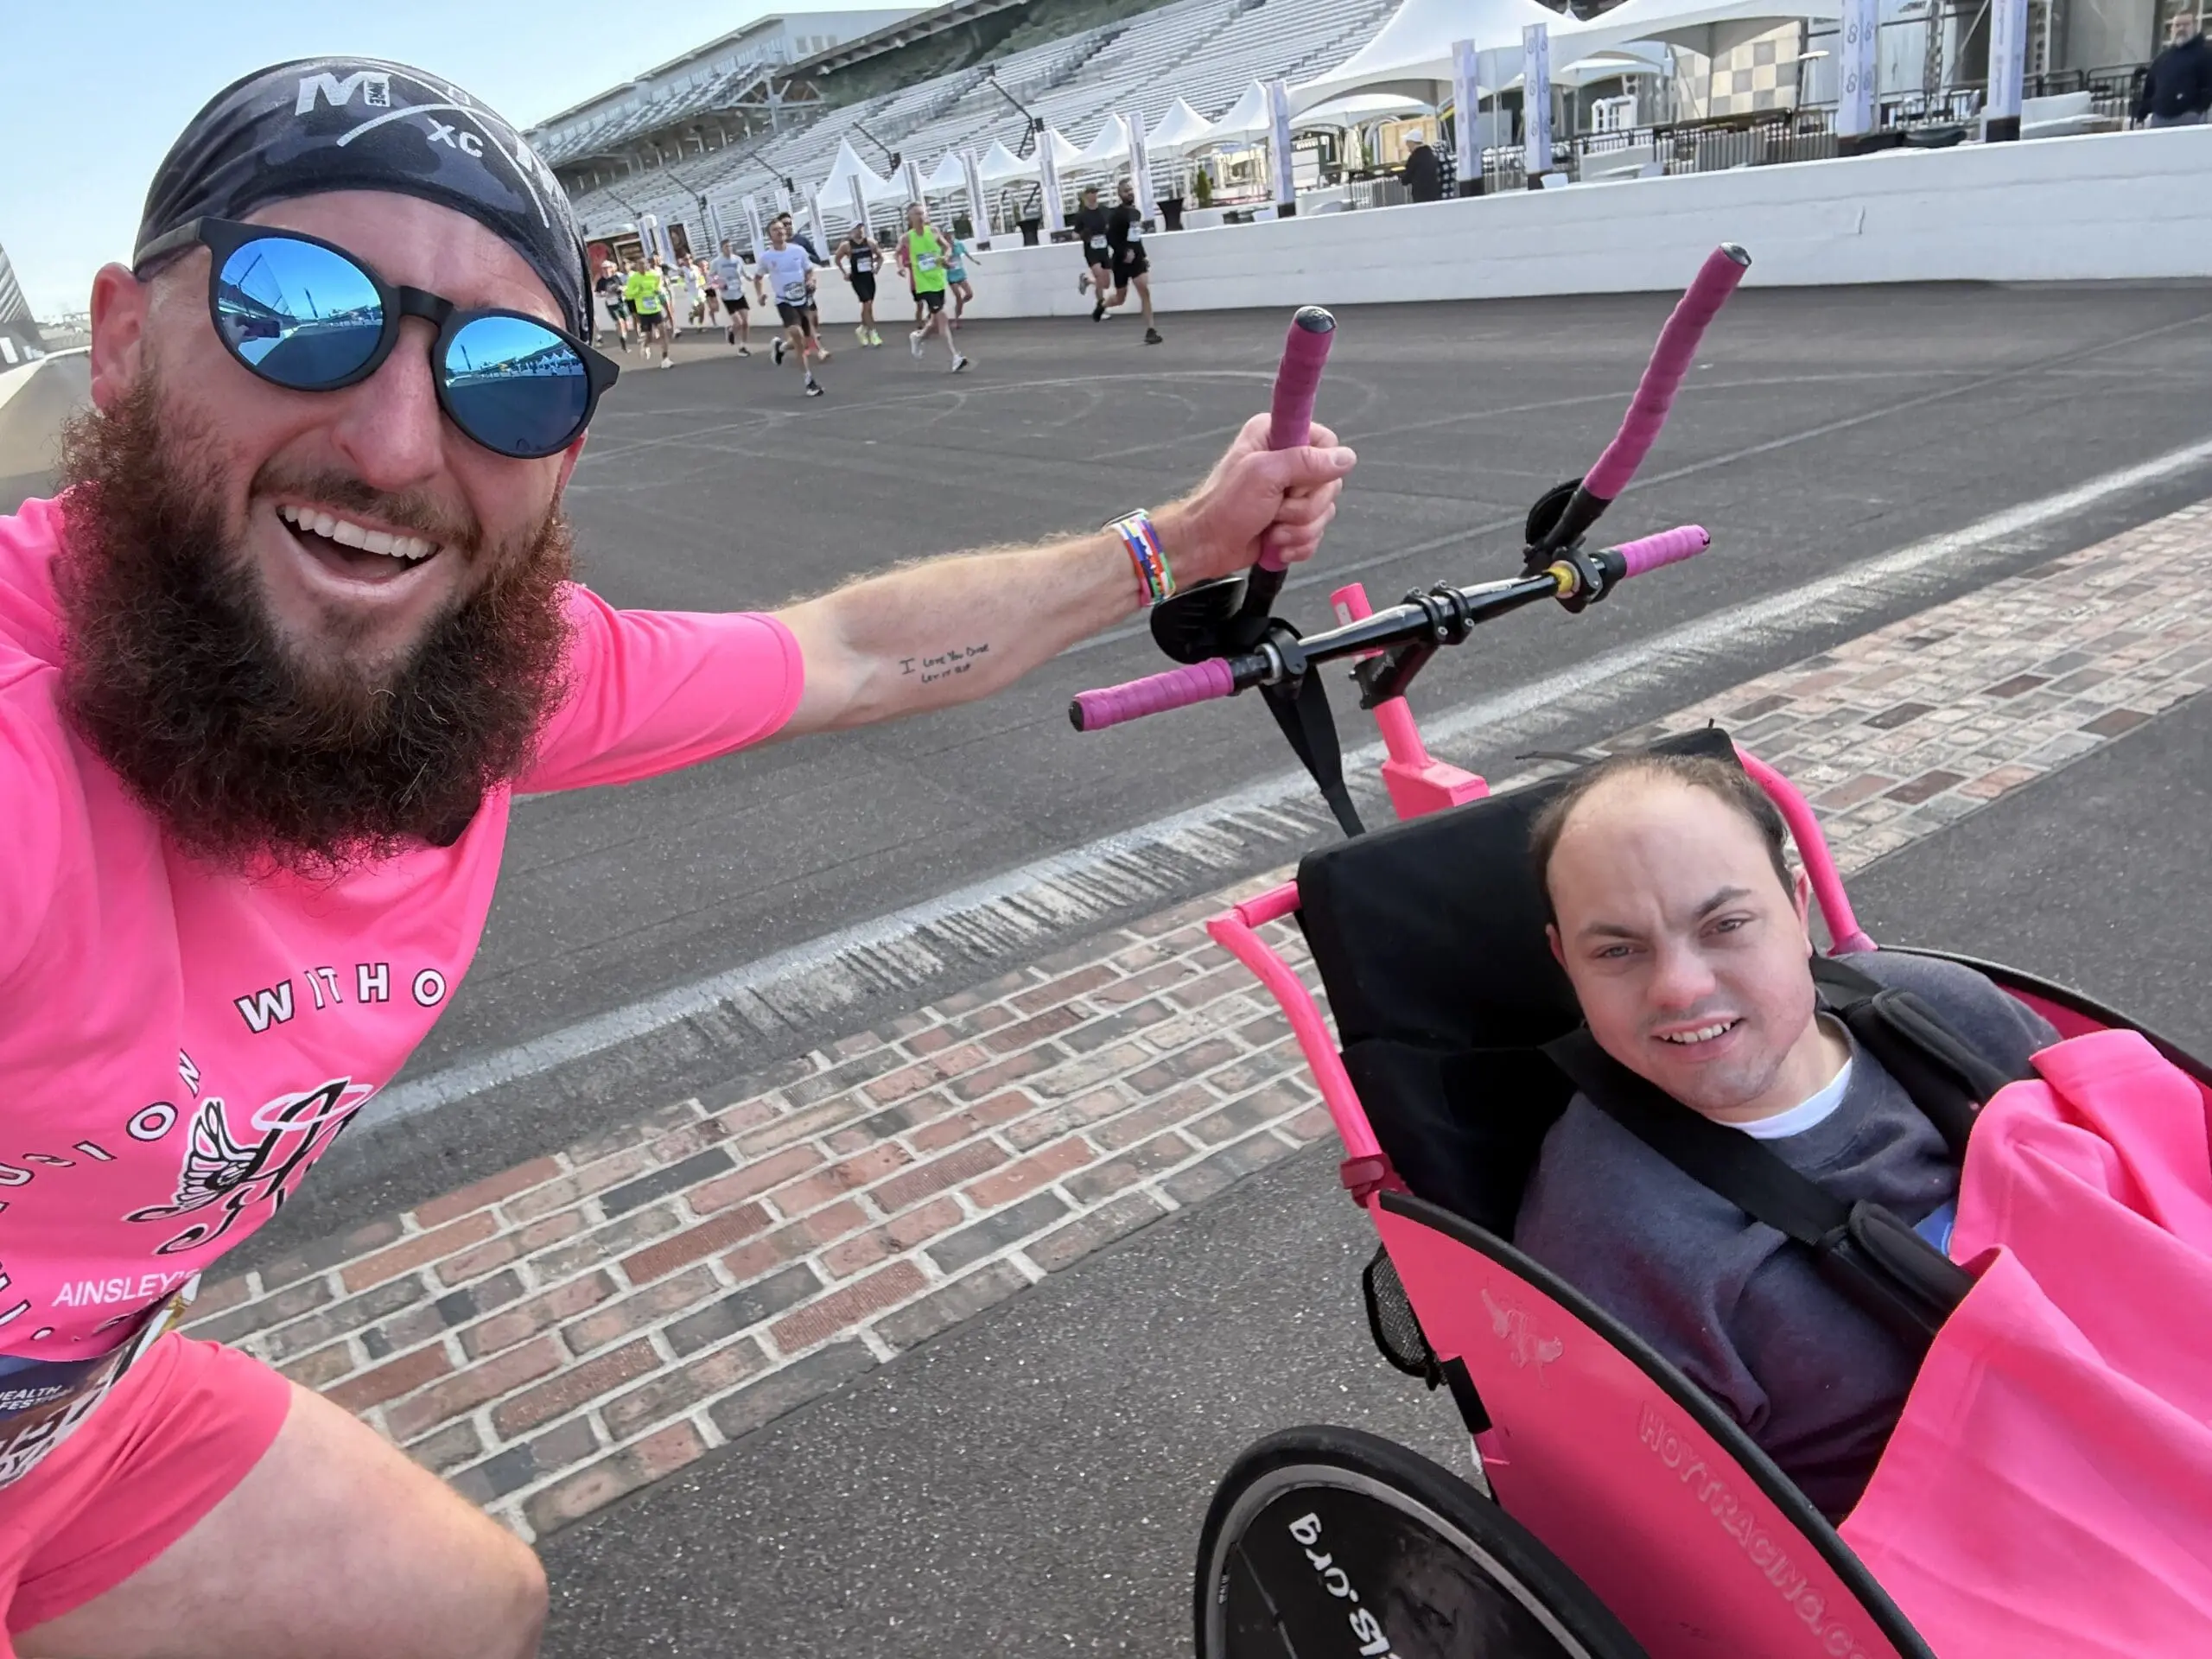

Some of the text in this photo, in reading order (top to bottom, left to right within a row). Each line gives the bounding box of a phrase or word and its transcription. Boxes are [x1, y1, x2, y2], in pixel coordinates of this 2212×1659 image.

[426, 117, 483, 157] XC
[899, 658, 916, 675] I
[1287, 1511, 1401, 1659] ls.org
